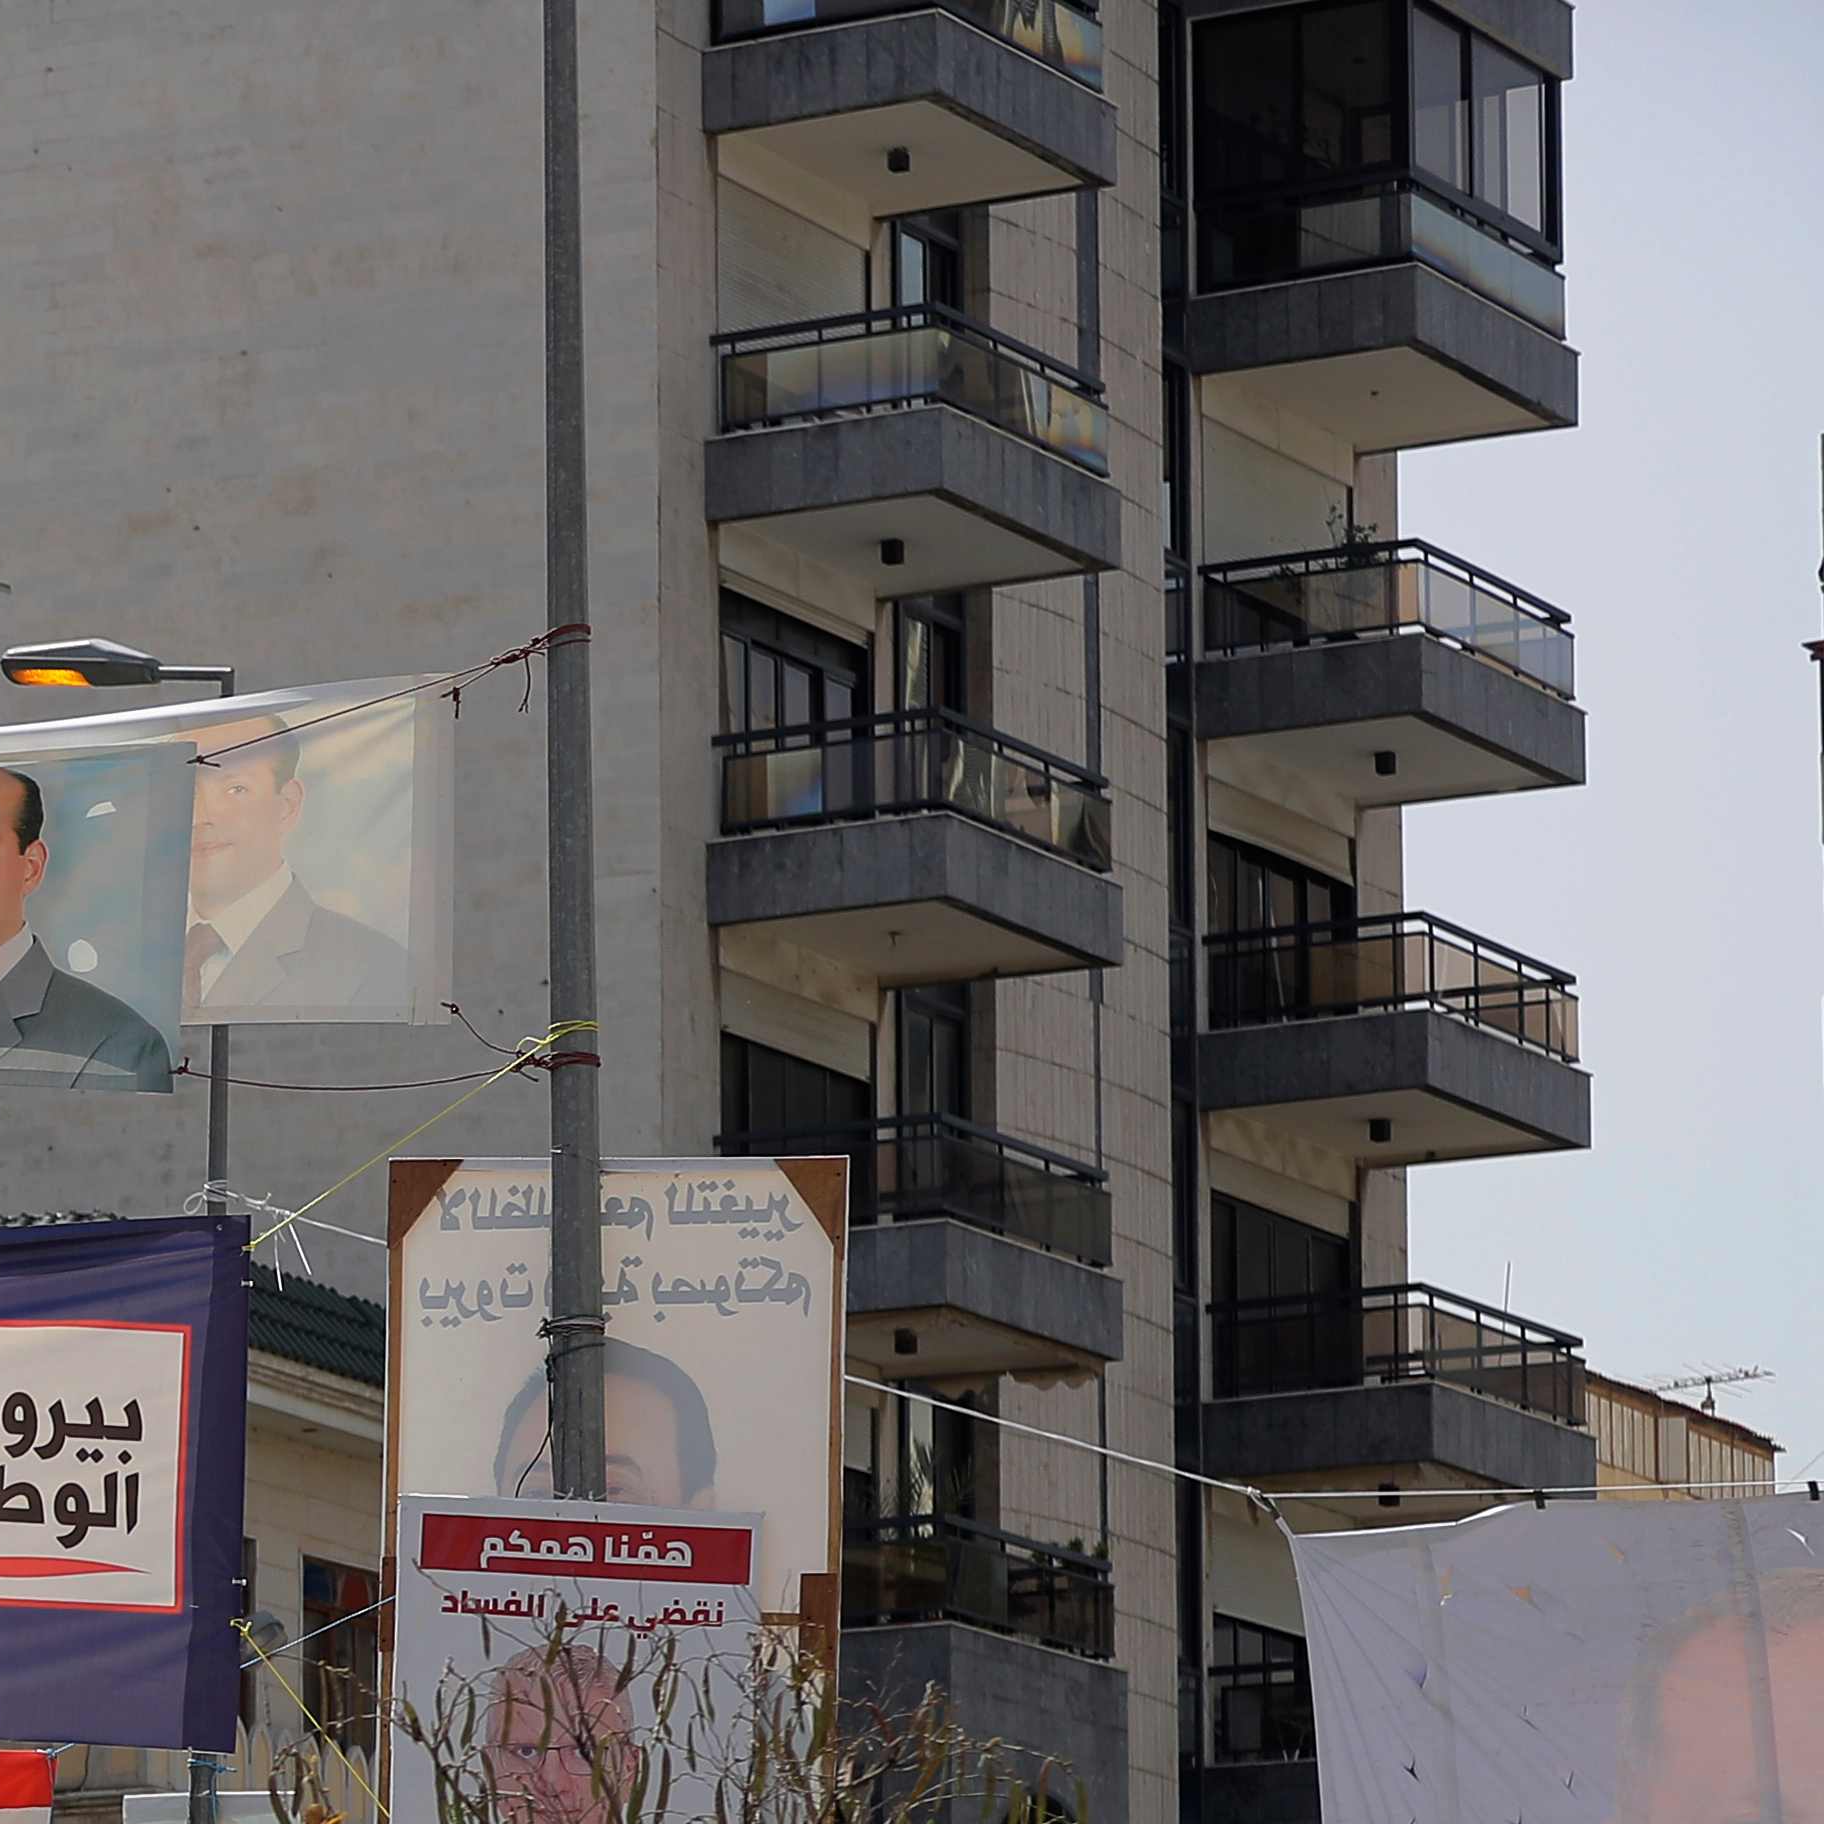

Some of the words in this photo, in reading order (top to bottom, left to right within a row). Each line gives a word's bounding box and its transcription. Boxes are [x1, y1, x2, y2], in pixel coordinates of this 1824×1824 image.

[480, 1530, 594, 1569] همكم
[441, 1590, 545, 1617] الفساد
[627, 1599, 725, 1639] نقضي
